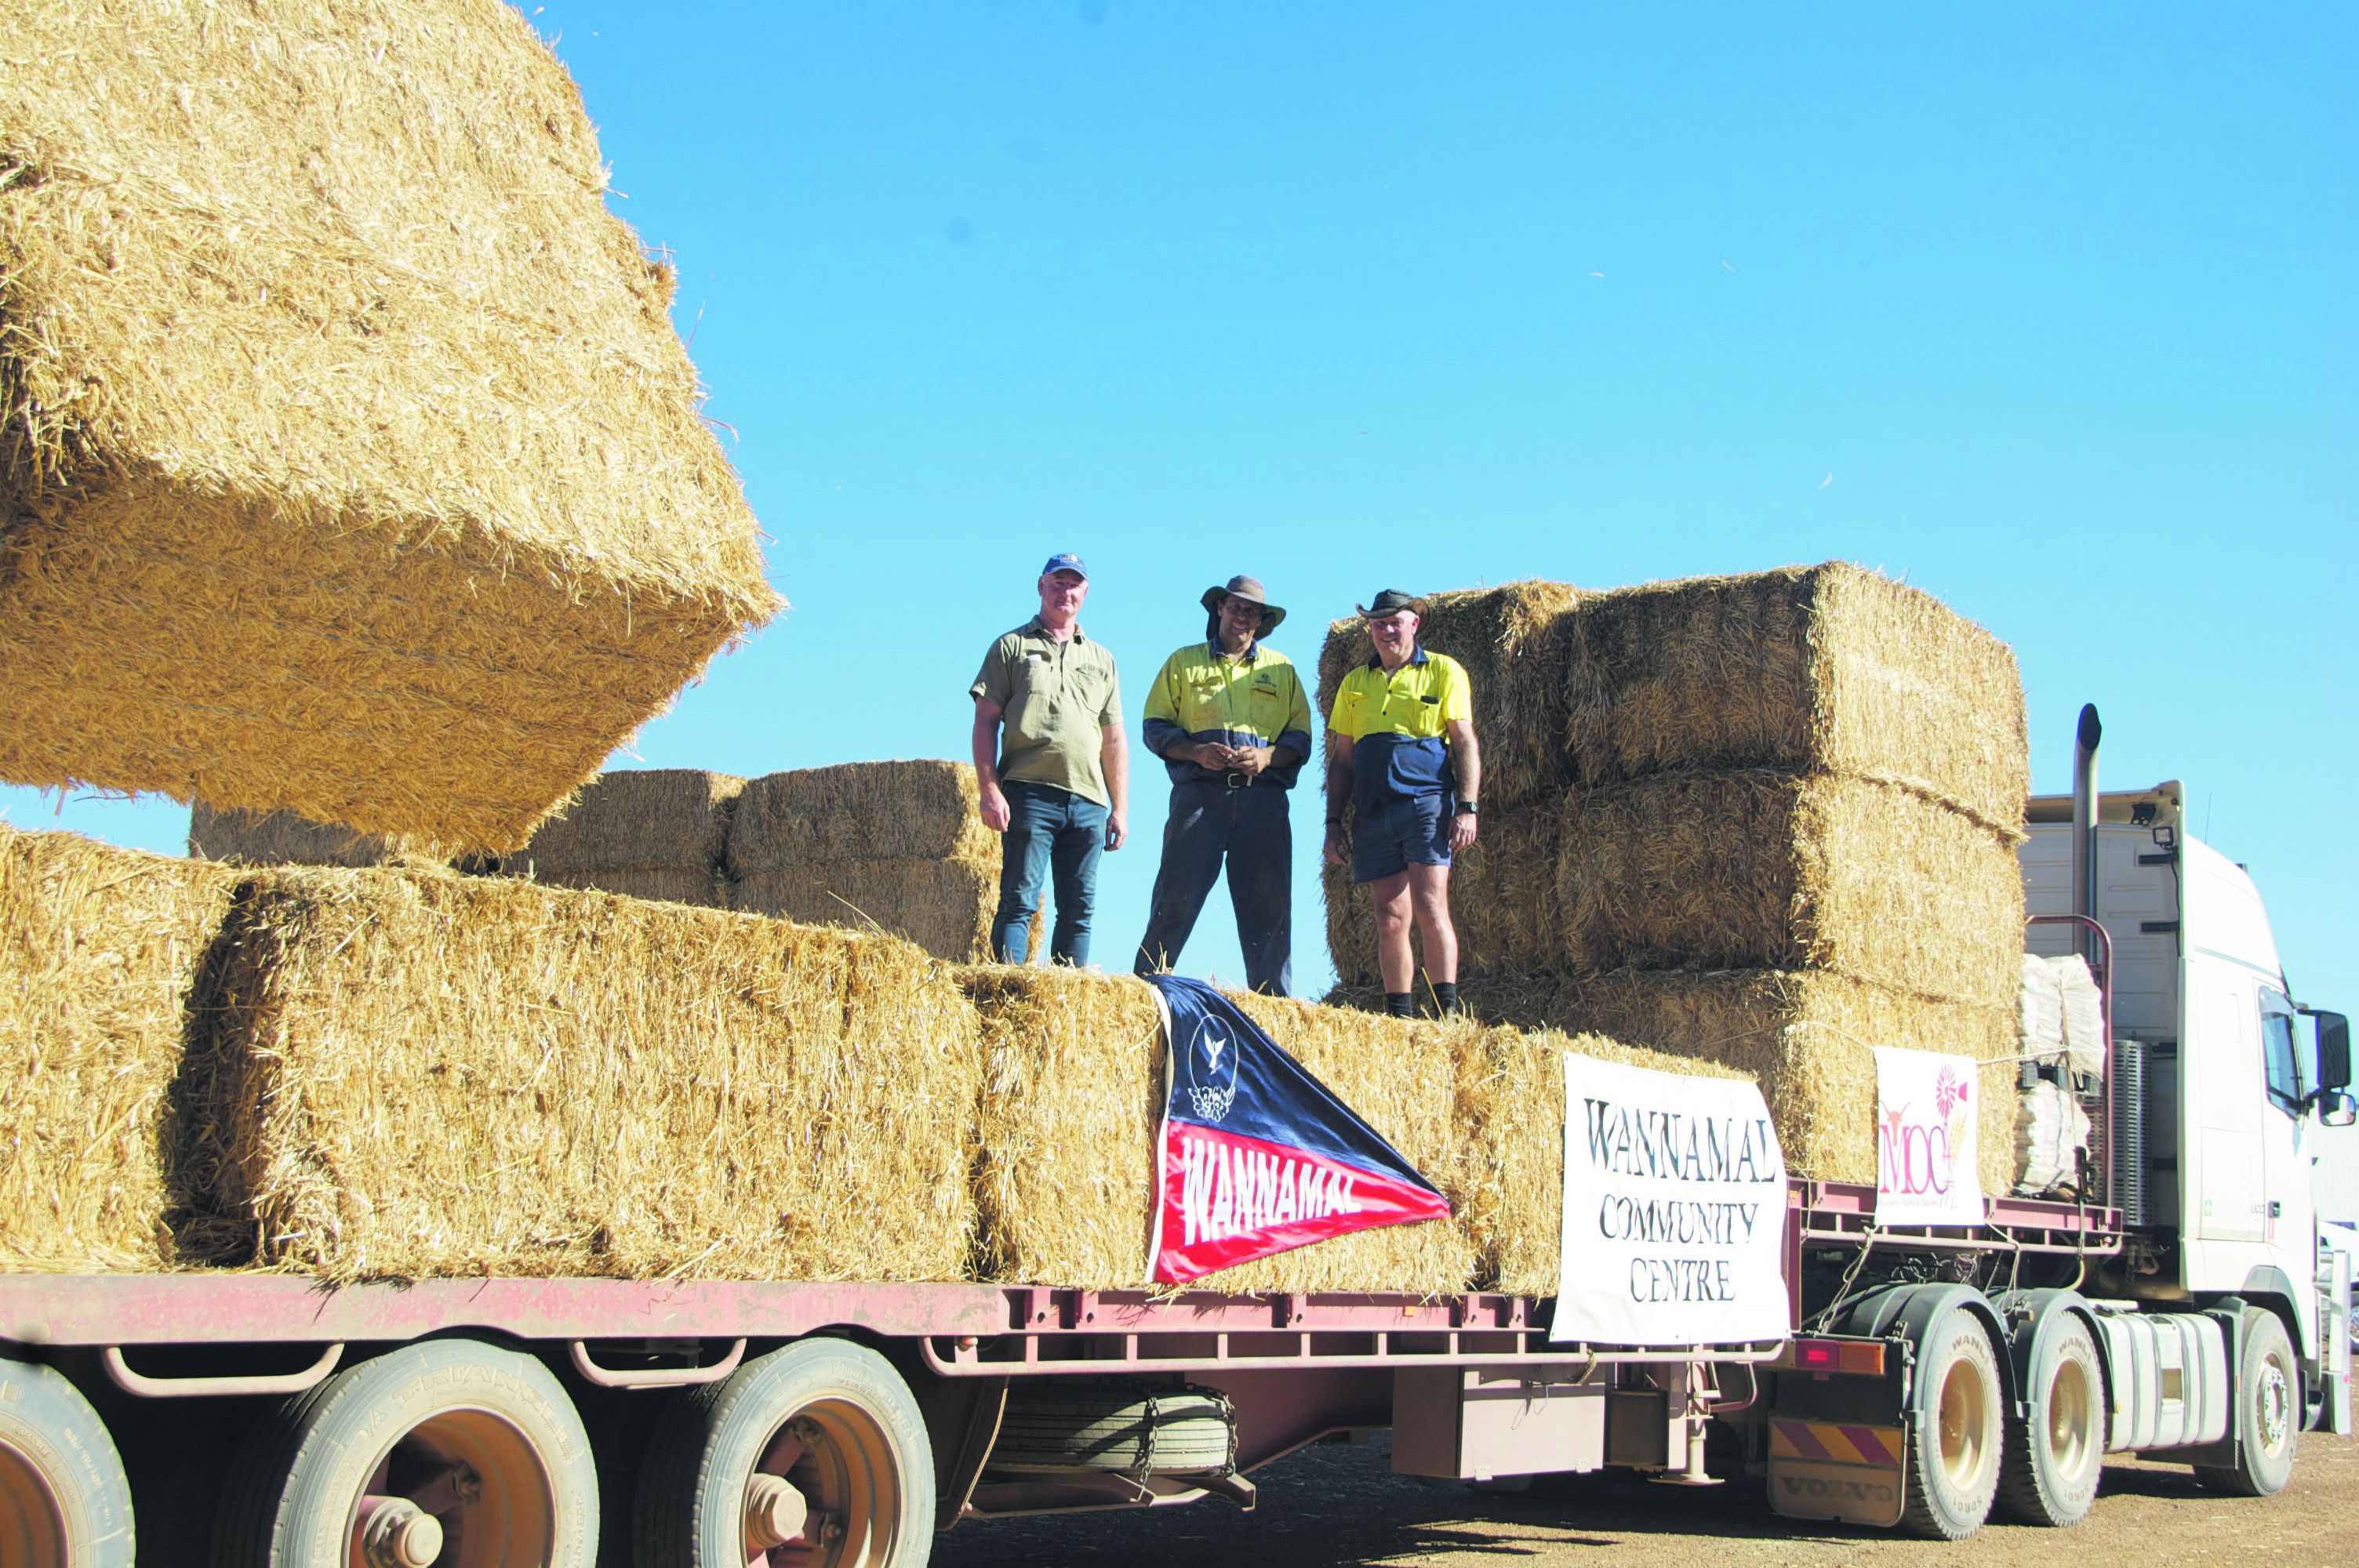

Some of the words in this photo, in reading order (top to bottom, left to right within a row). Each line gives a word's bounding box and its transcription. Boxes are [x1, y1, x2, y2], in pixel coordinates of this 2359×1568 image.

[1584, 1098, 1776, 1183] WANNAMAL
[1183, 1138, 1361, 1247] WANNAMAL
[1600, 1194, 1758, 1244] COMMUNITY
[1630, 1258, 1735, 1302] CENTRE
[392, 1363, 576, 1461] TRIANGLE
[1779, 1476, 1893, 1502] VOLVO
